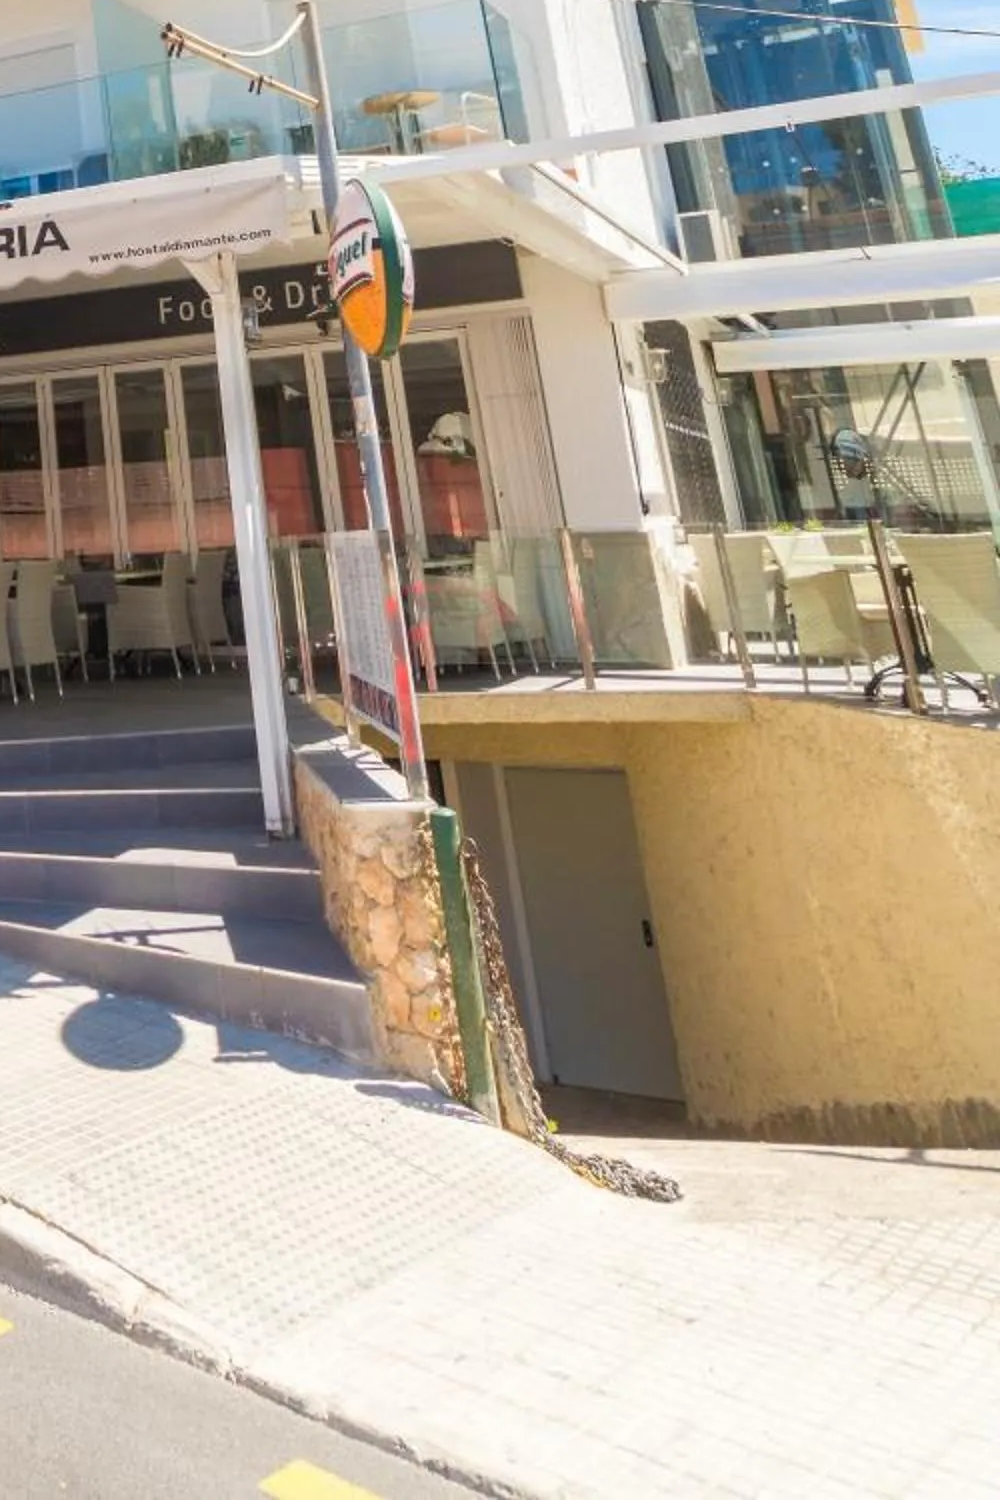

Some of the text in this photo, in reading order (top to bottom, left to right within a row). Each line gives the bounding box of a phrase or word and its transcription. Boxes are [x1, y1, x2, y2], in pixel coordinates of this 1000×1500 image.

[88, 227, 272, 264] www.hostaldiamante.com
[336, 231, 369, 277] guel
[158, 296, 214, 325] Foo
[253, 285, 273, 313] &
